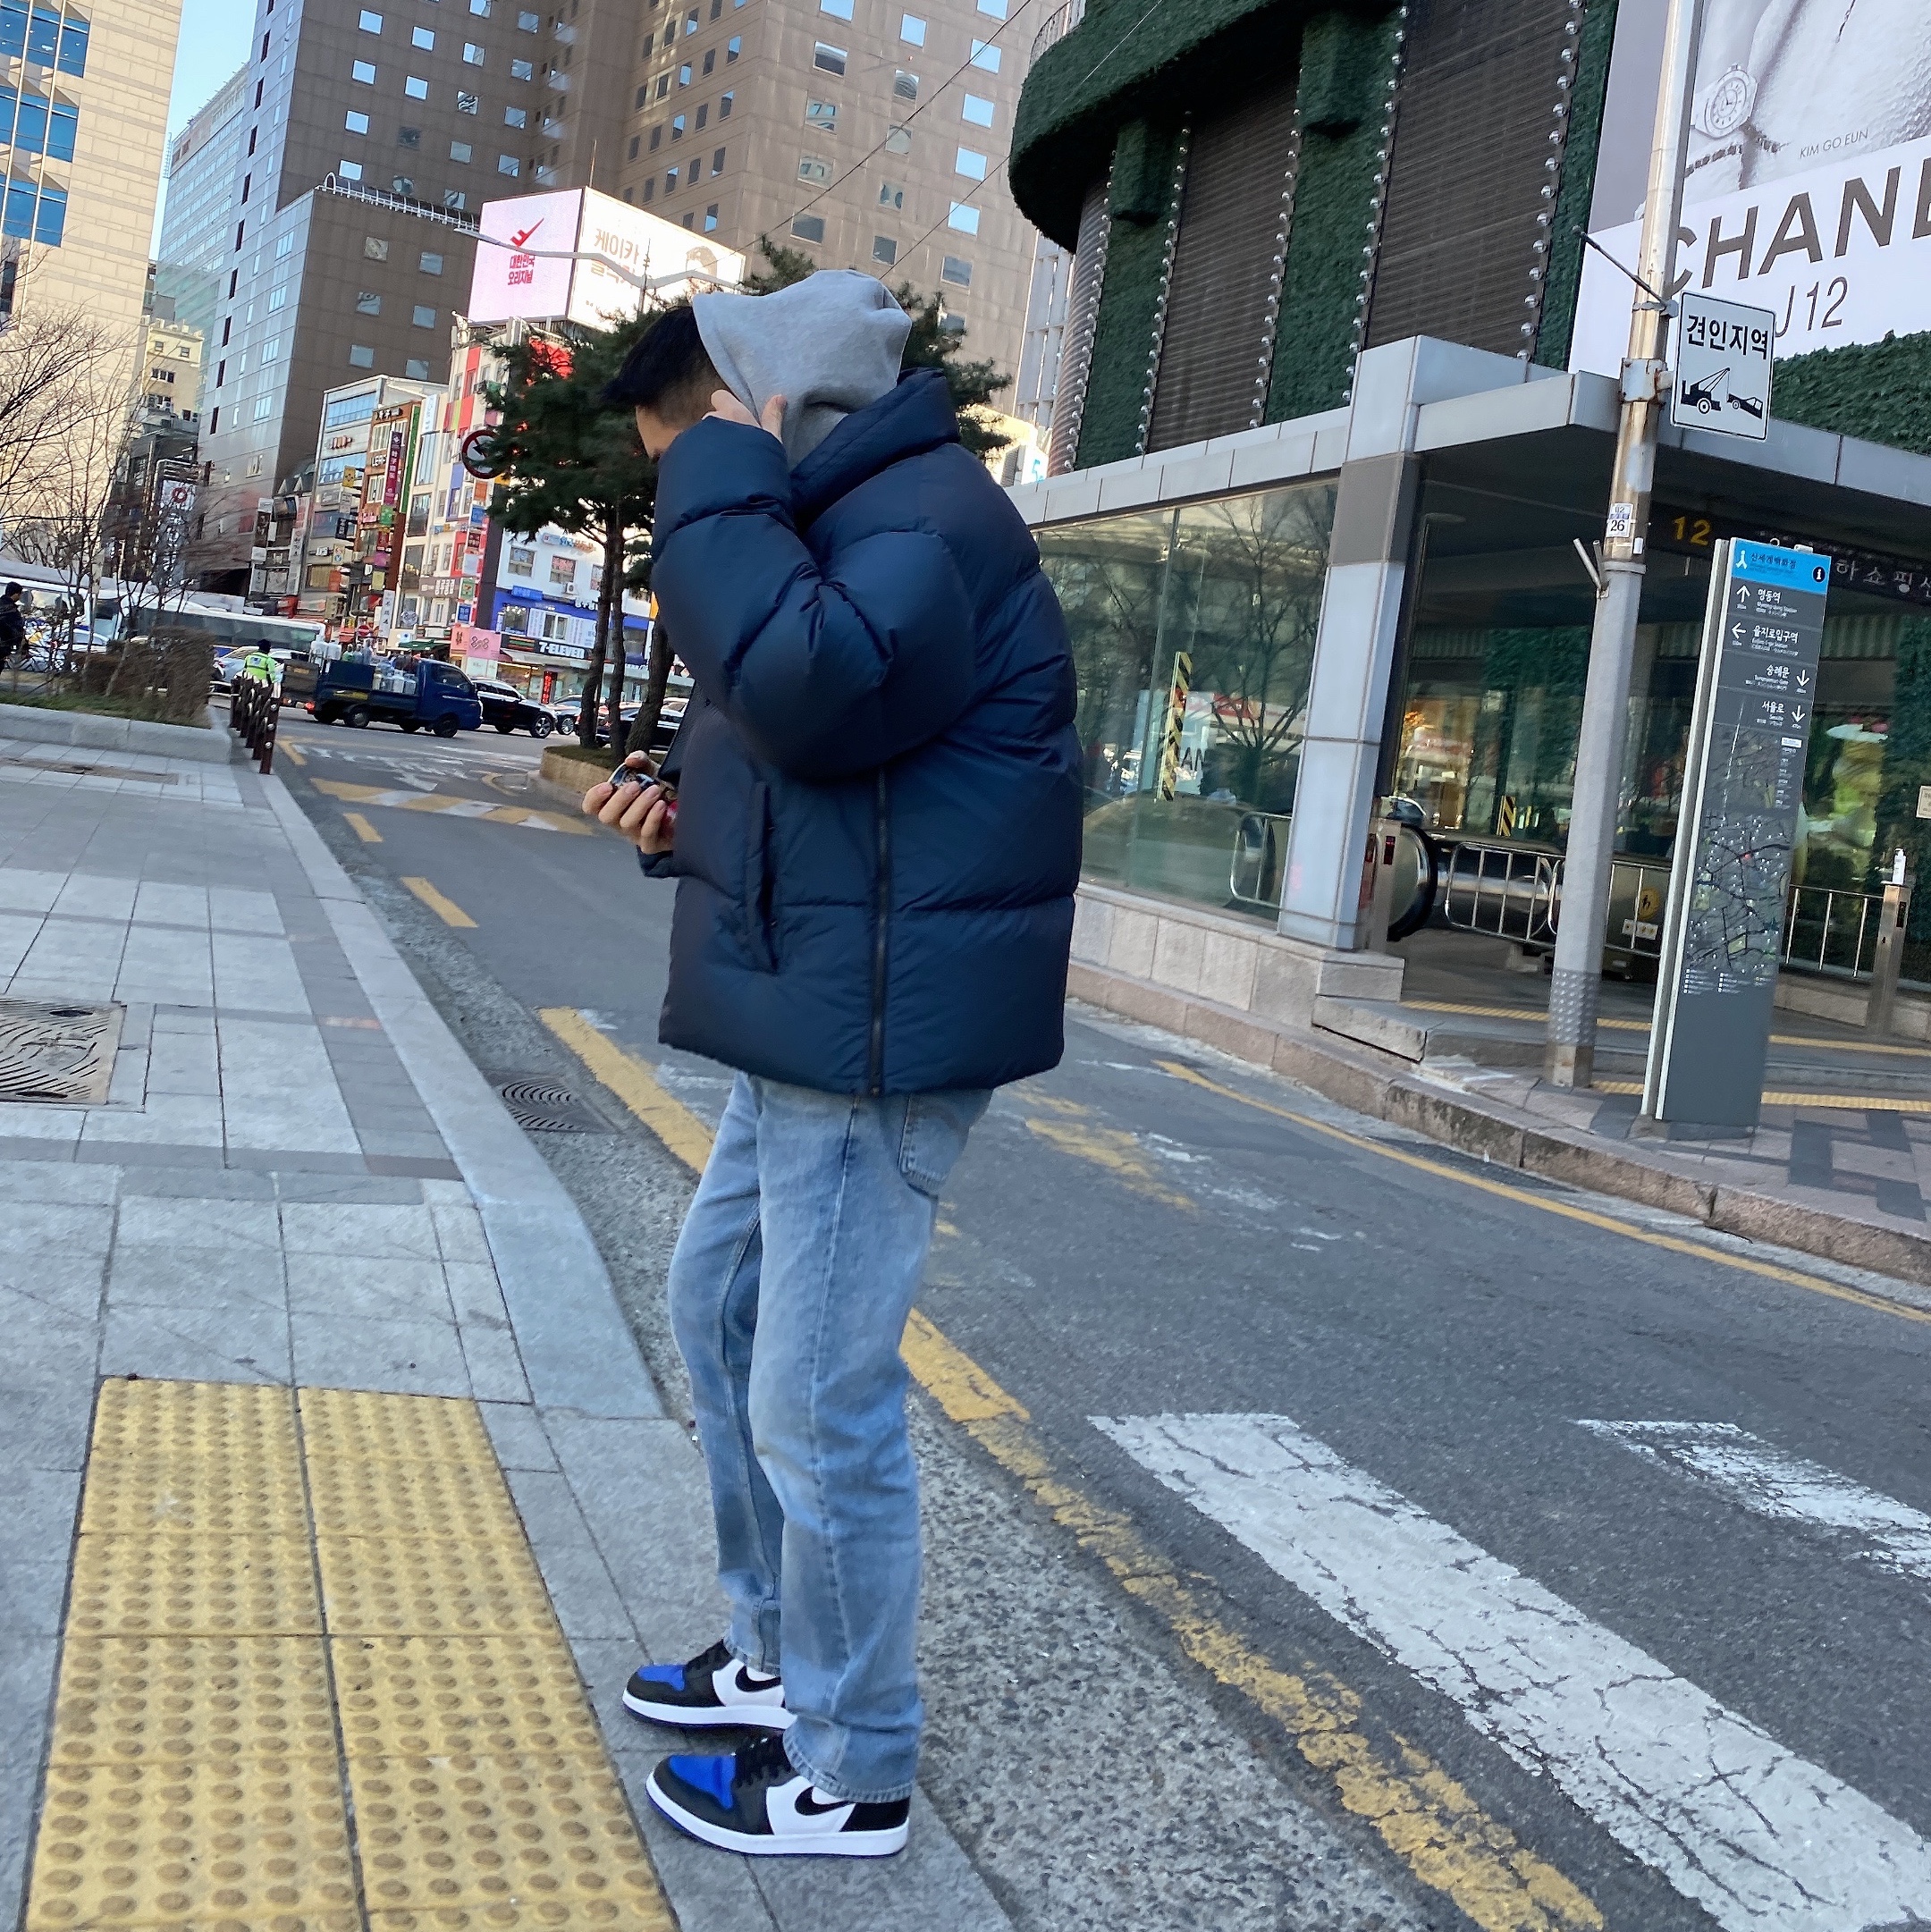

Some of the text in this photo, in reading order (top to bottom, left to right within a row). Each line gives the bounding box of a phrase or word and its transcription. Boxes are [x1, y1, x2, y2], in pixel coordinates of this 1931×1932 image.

[1799, 129, 1868, 159] KIM GO EUN
[509, 254, 535, 269] 대한민국
[507, 269, 534, 285] 오리지널
[1775, 276, 1849, 339] J12
[1686, 314, 1769, 359] 견인지역
[1610, 519, 1625, 532] 26
[1672, 516, 1712, 545] 12
[1750, 553, 1797, 569] 신세계백화점
[1757, 588, 1782, 603] 명동역
[1752, 624, 1799, 645] 을지로입구역
[1766, 664, 1791, 679] 숭례문
[1761, 700, 1785, 713] 서울로
